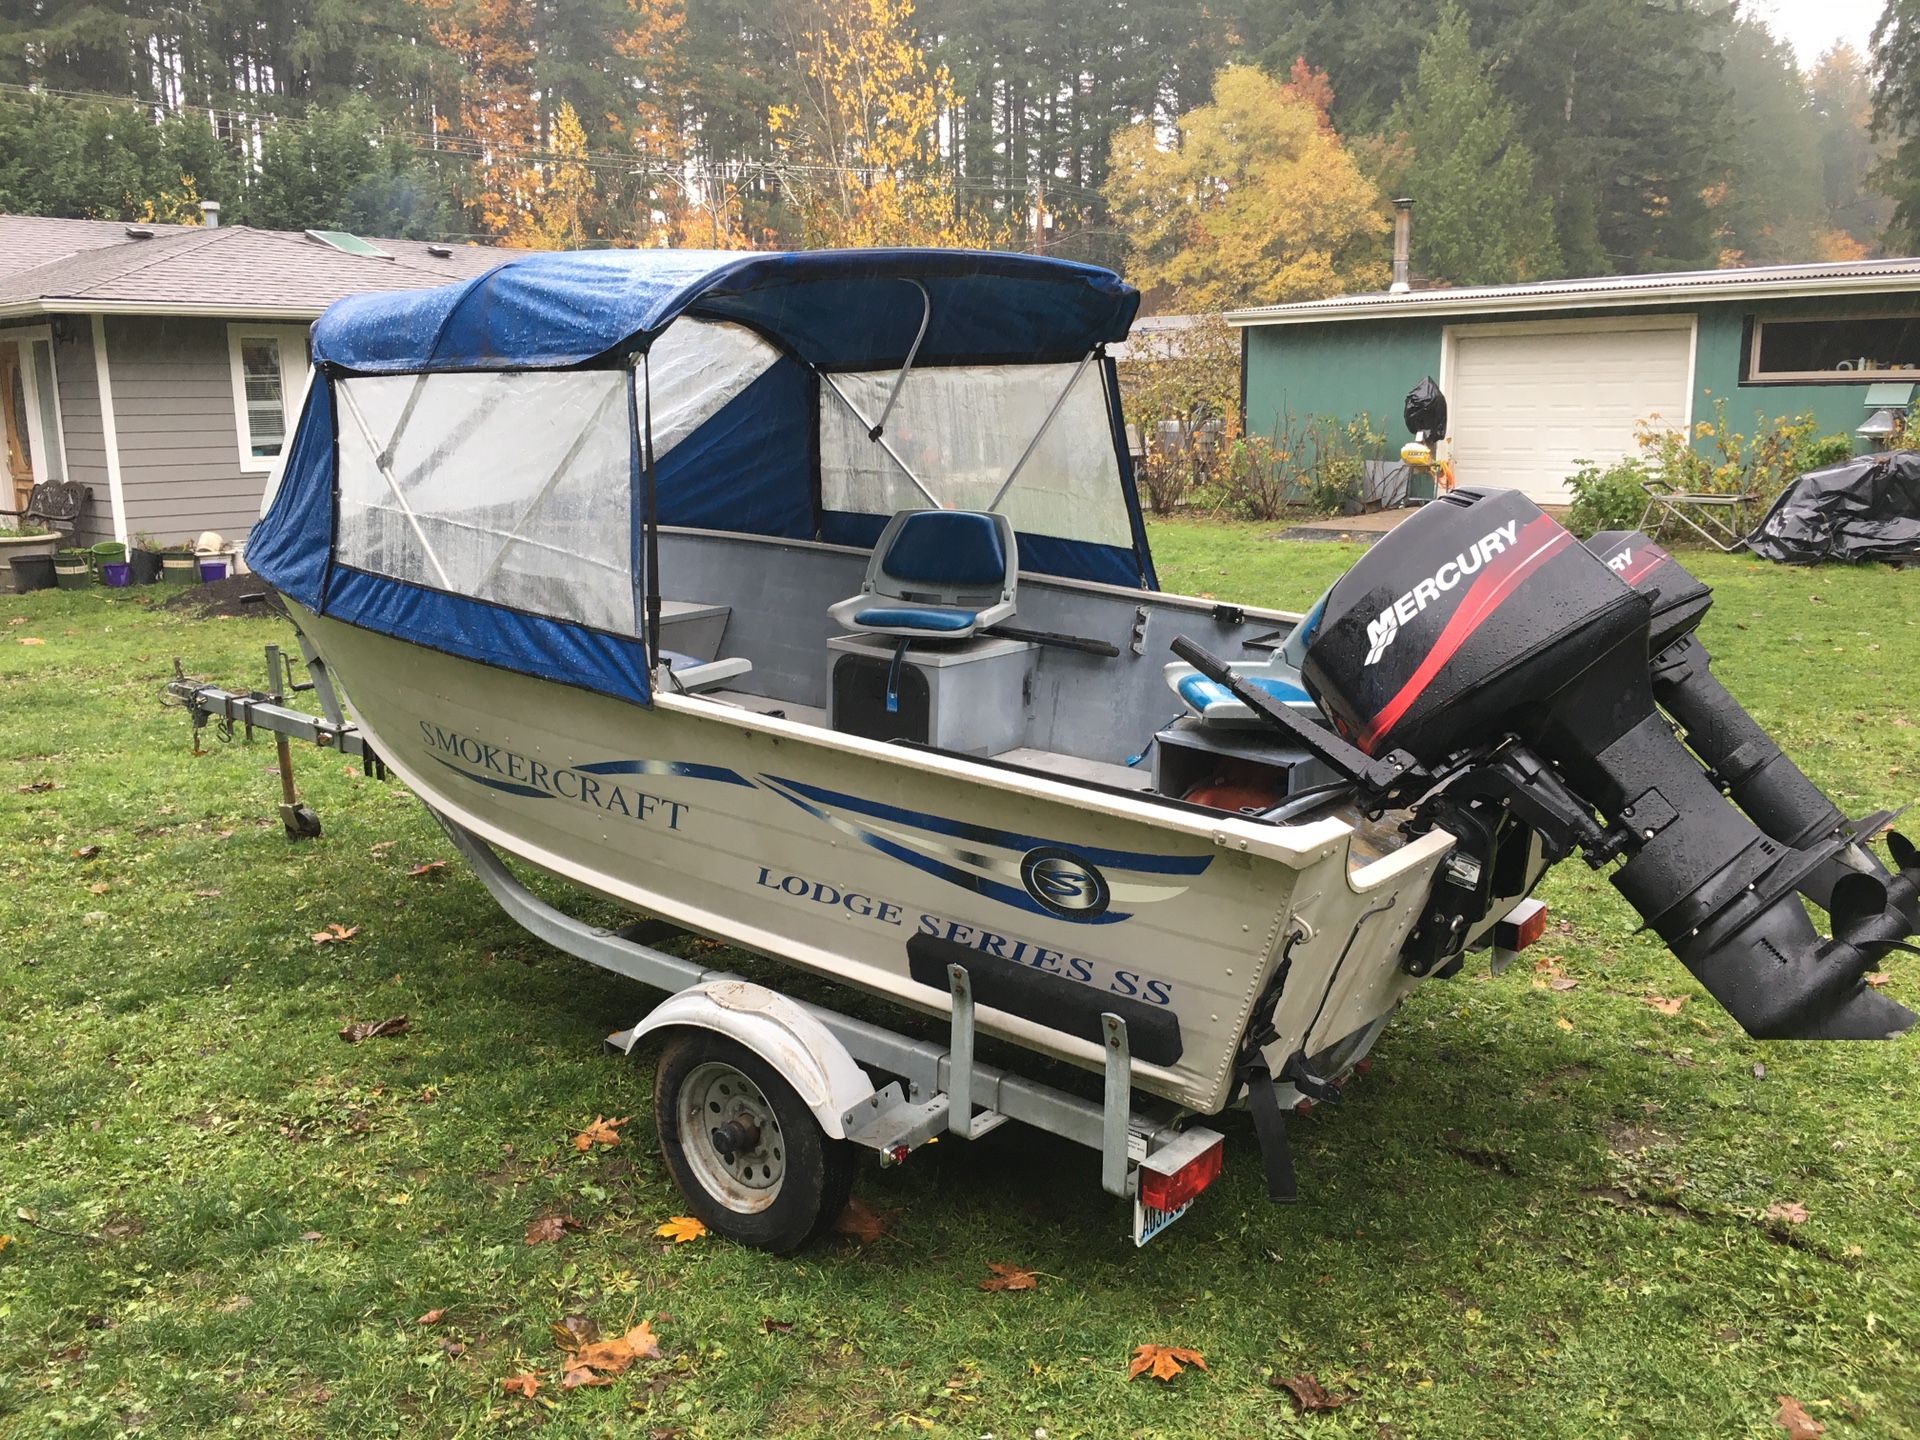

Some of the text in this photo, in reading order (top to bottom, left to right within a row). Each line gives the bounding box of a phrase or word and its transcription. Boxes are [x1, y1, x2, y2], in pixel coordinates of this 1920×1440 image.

[1364, 519, 1517, 667] MERCURY
[419, 720, 689, 831] SMOKERCRAFT
[757, 866, 1172, 1006] LODGE SERIES SS
